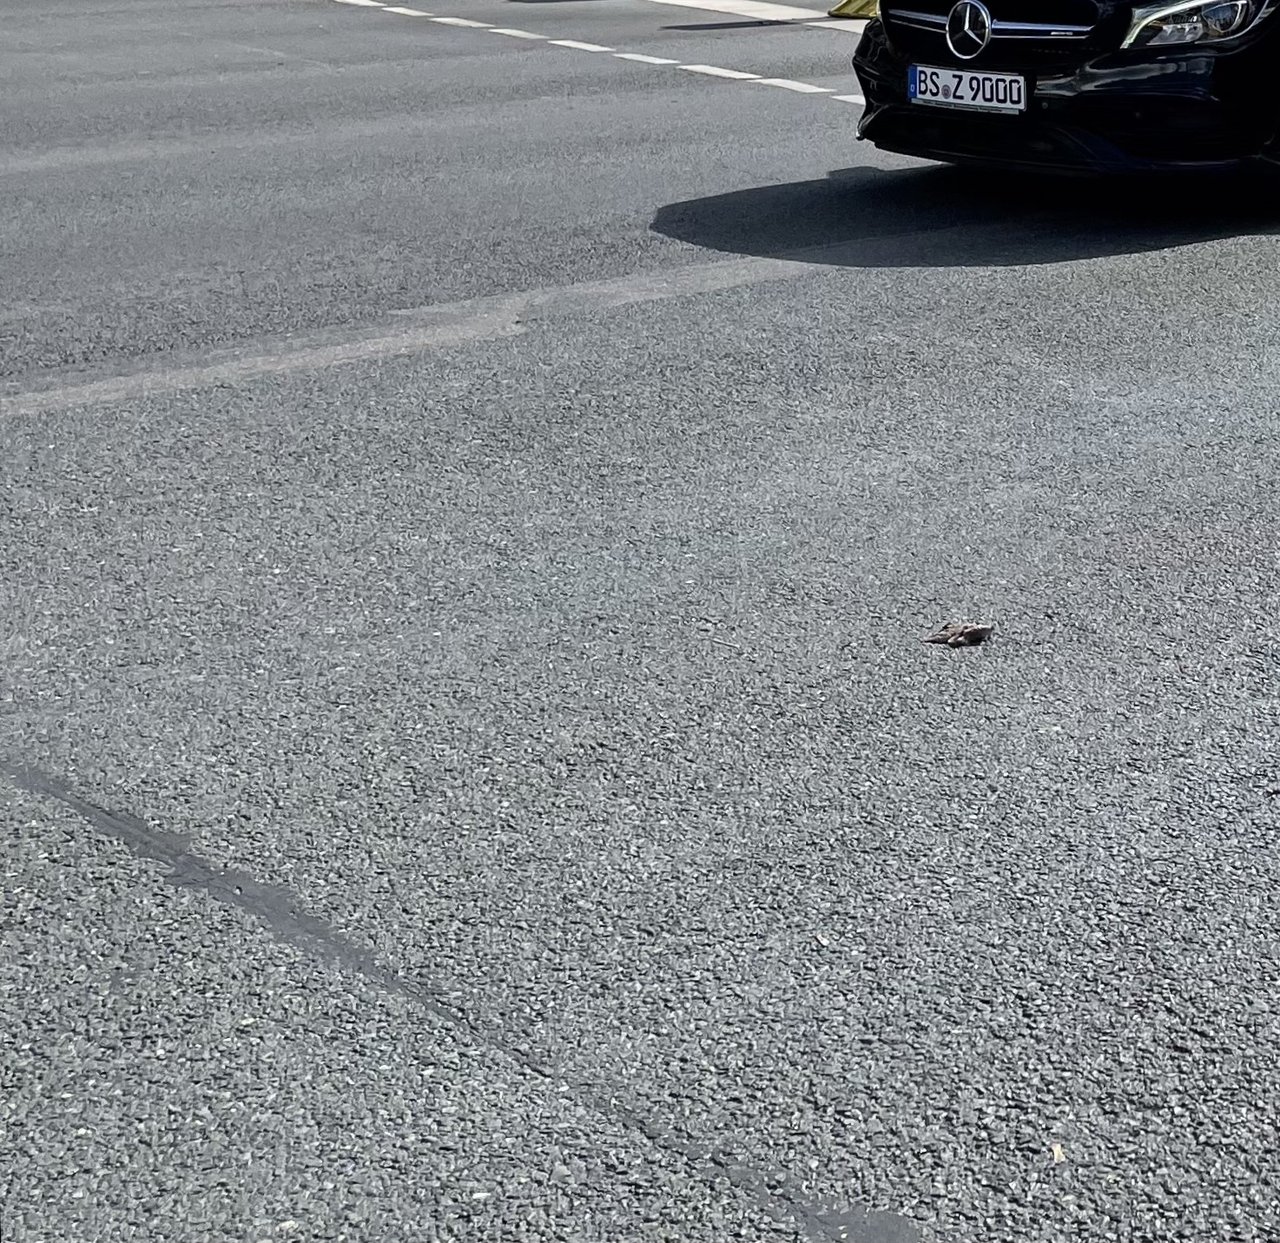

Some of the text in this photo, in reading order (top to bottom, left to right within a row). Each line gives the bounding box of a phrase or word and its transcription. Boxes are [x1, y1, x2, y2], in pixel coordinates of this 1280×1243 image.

[918, 69, 1022, 105] BS Z 9000
